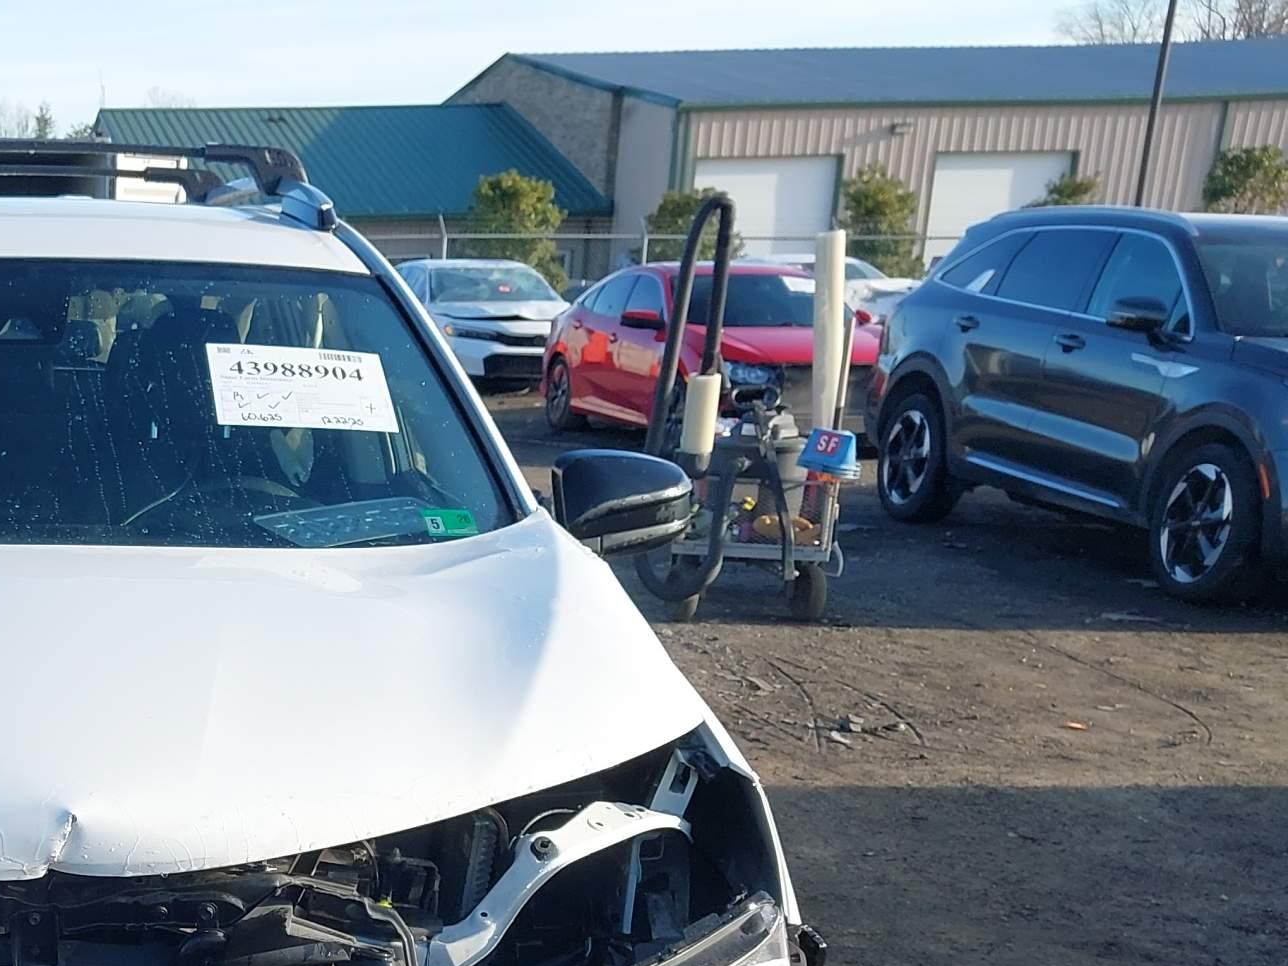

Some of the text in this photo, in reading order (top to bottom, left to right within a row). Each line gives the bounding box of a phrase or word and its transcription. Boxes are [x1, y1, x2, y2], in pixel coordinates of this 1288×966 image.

[229, 360, 364, 382] 43988904
[817, 435, 840, 453] SF
[430, 518, 441, 530] 5
